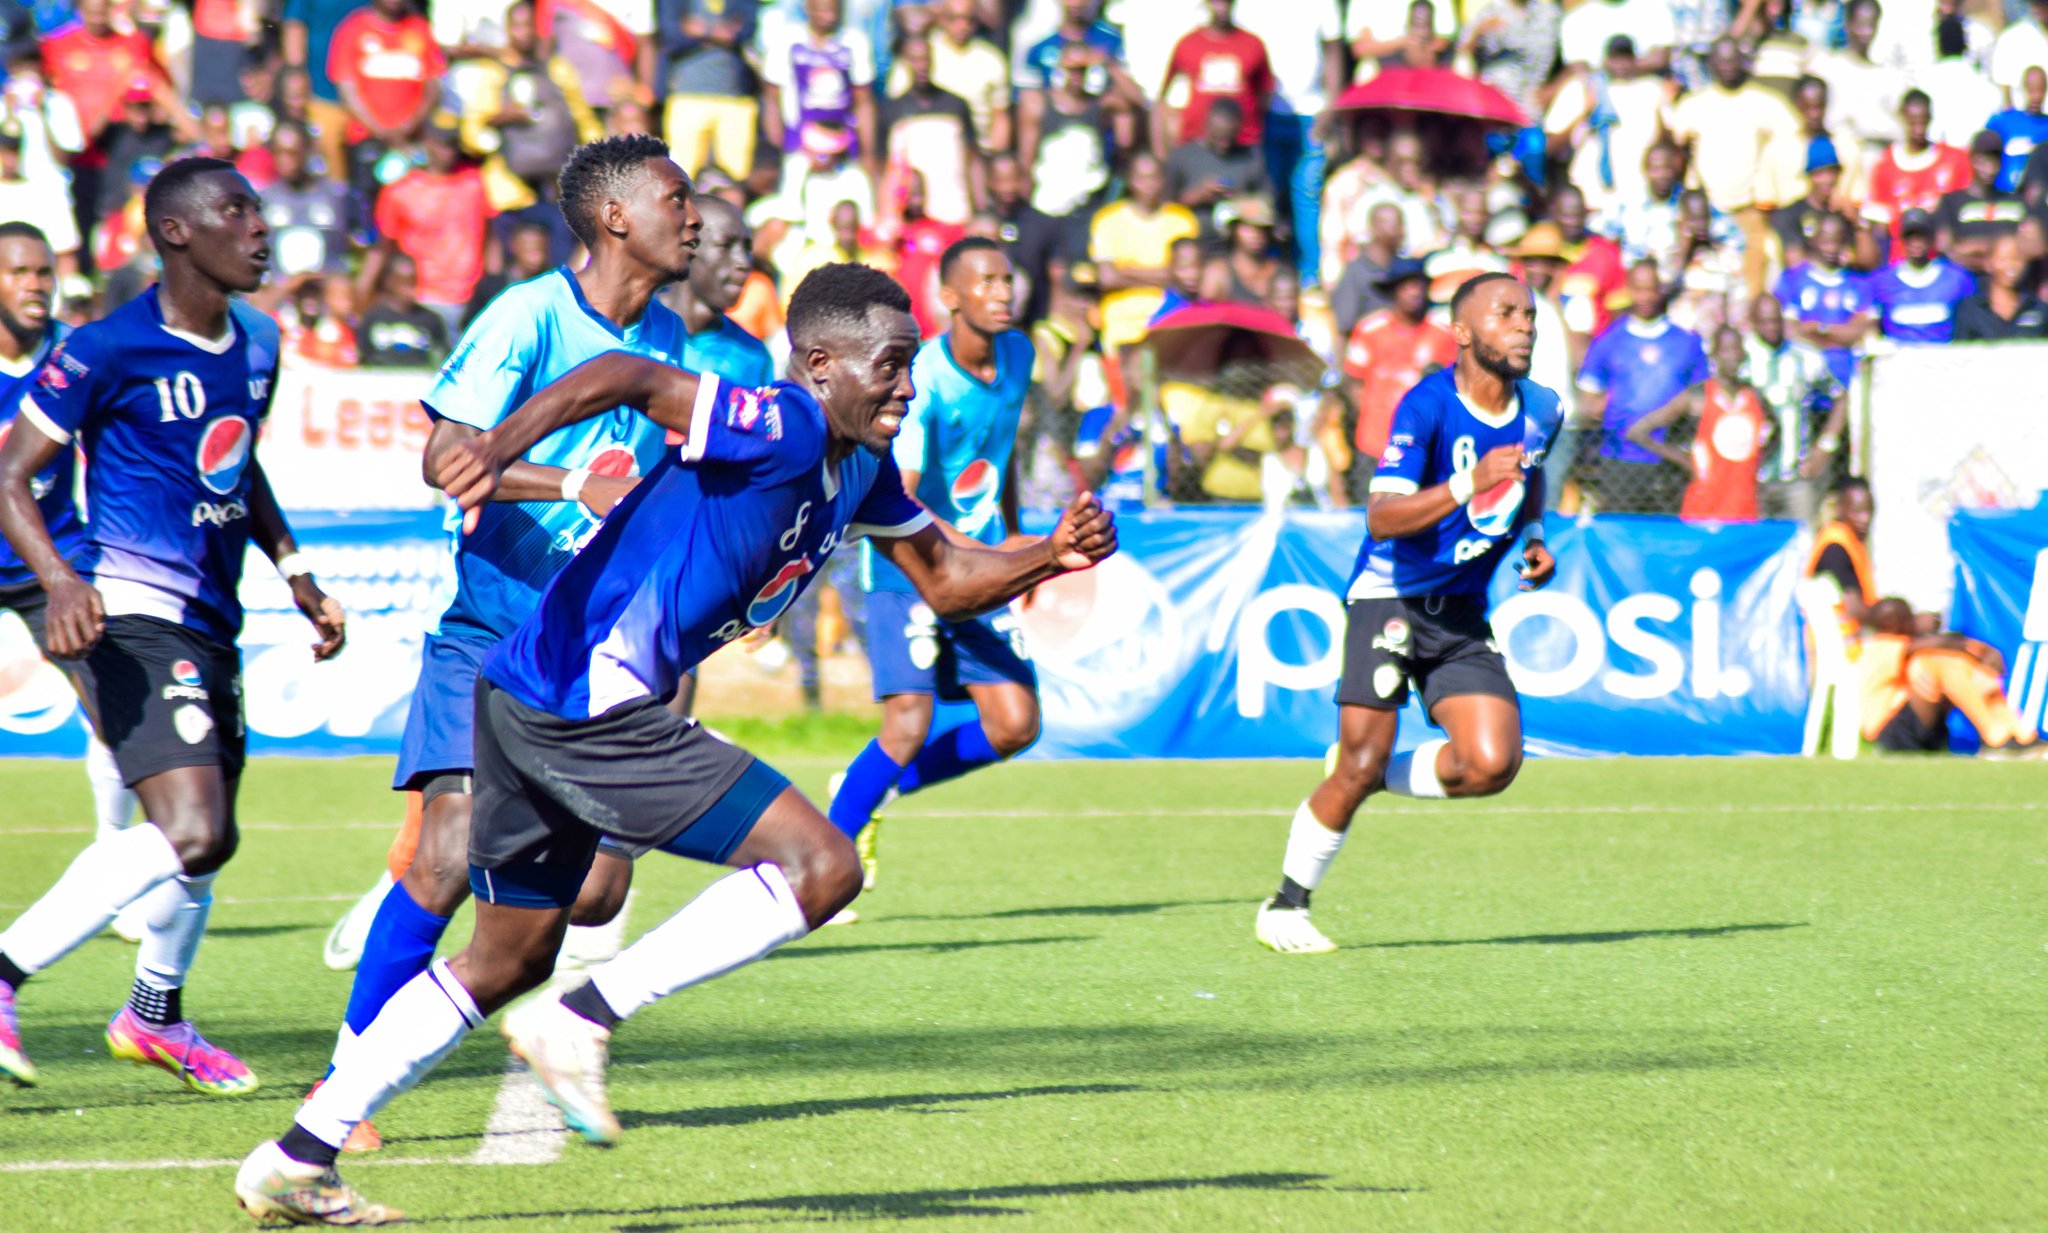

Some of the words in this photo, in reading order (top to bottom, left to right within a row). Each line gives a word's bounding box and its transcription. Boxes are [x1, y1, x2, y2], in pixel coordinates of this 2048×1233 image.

[154, 370, 207, 422] 10
[303, 384, 432, 452] Leag
[1453, 435, 1479, 474] 6
